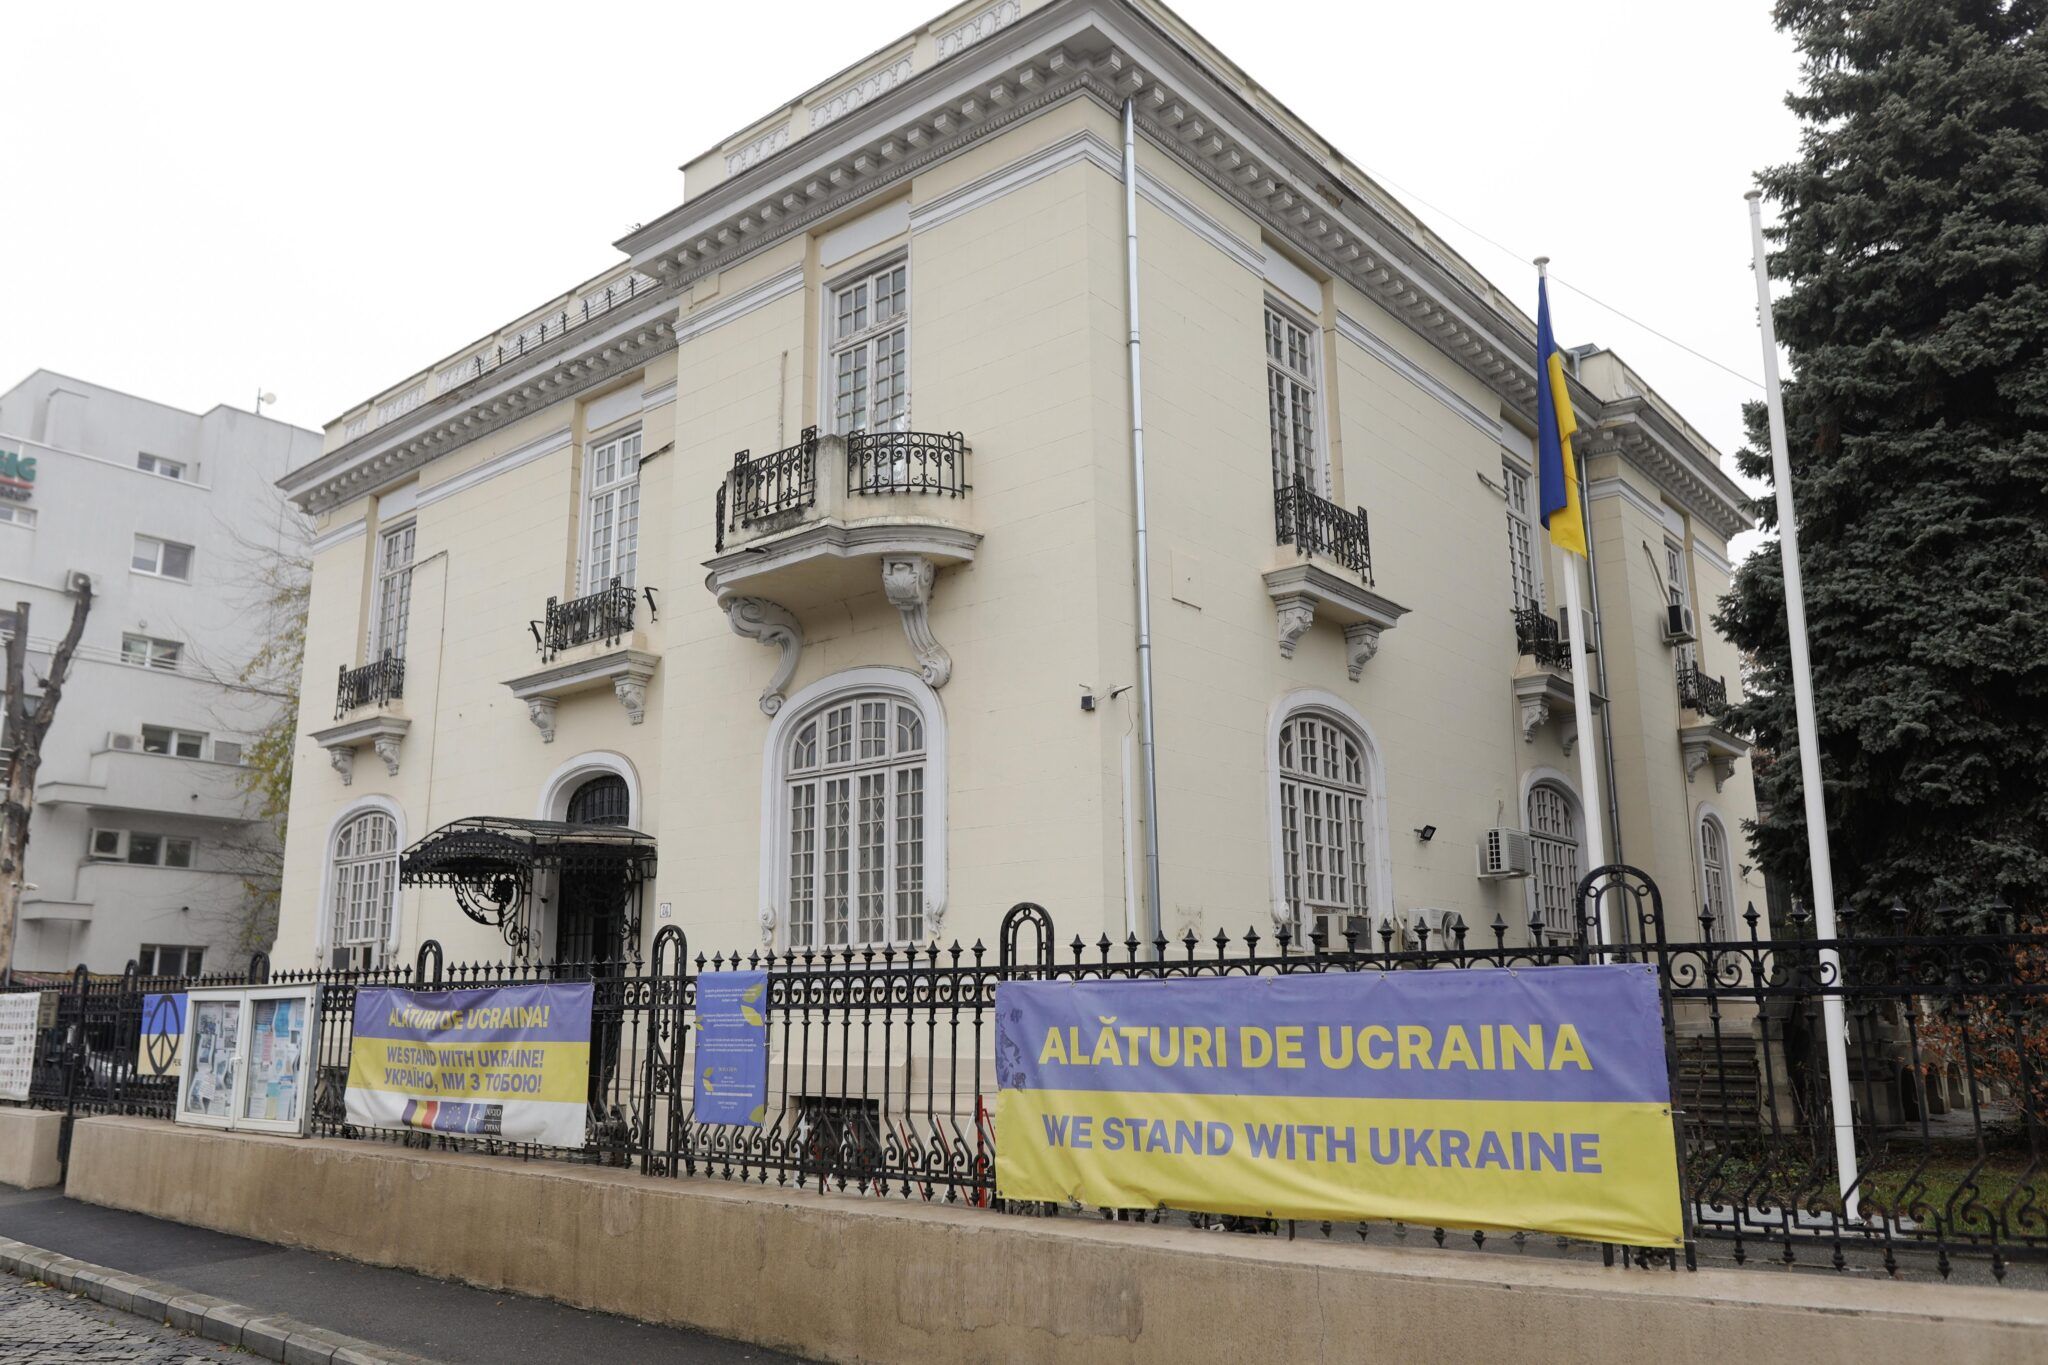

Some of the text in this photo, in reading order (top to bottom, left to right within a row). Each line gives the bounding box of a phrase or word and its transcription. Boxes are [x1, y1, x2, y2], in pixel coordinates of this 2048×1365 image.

[388, 1003, 550, 1031] ALĂTURI DE UCRAINA!
[1038, 1015, 1594, 1071] ALĂTURI DE UCRAINA
[439, 1050, 475, 1068] WITH
[478, 1049, 545, 1068] UKRAINE!
[384, 1066, 438, 1093] УКРАЇНО,
[441, 1072, 465, 1091] МИ
[485, 1073, 542, 1093] ТОБОЮ!
[486, 1107, 502, 1117] NATO
[1041, 1113, 1602, 1174] WE STAND WITH UKRAINE
